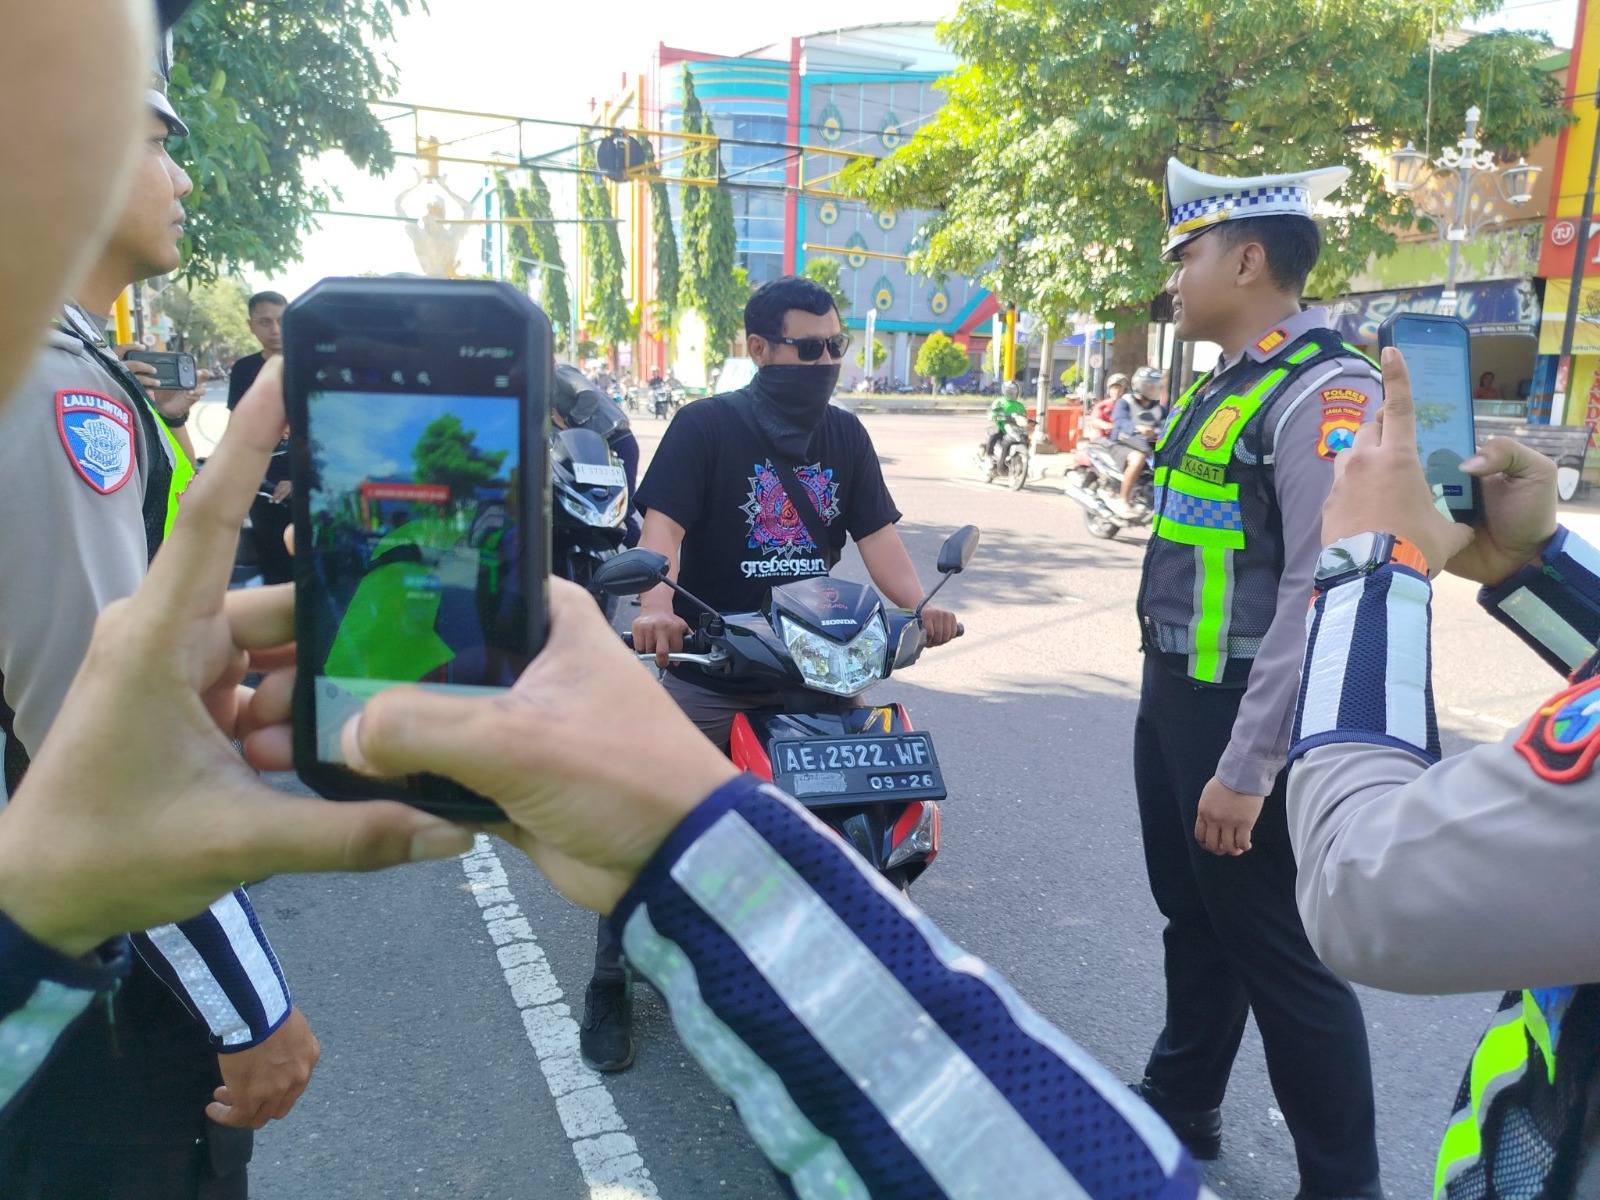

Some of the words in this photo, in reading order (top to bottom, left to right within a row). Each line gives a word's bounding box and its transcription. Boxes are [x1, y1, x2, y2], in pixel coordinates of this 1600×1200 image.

[1555, 226, 1572, 240] TJ
[1323, 389, 1366, 402] POLRES
[63, 394, 94, 407] LALU
[97, 398, 129, 425] LINTAS
[1184, 458, 1219, 480] KASAT
[787, 747, 817, 771] AE
[826, 744, 887, 768] 2522
[895, 742, 926, 766] WF
